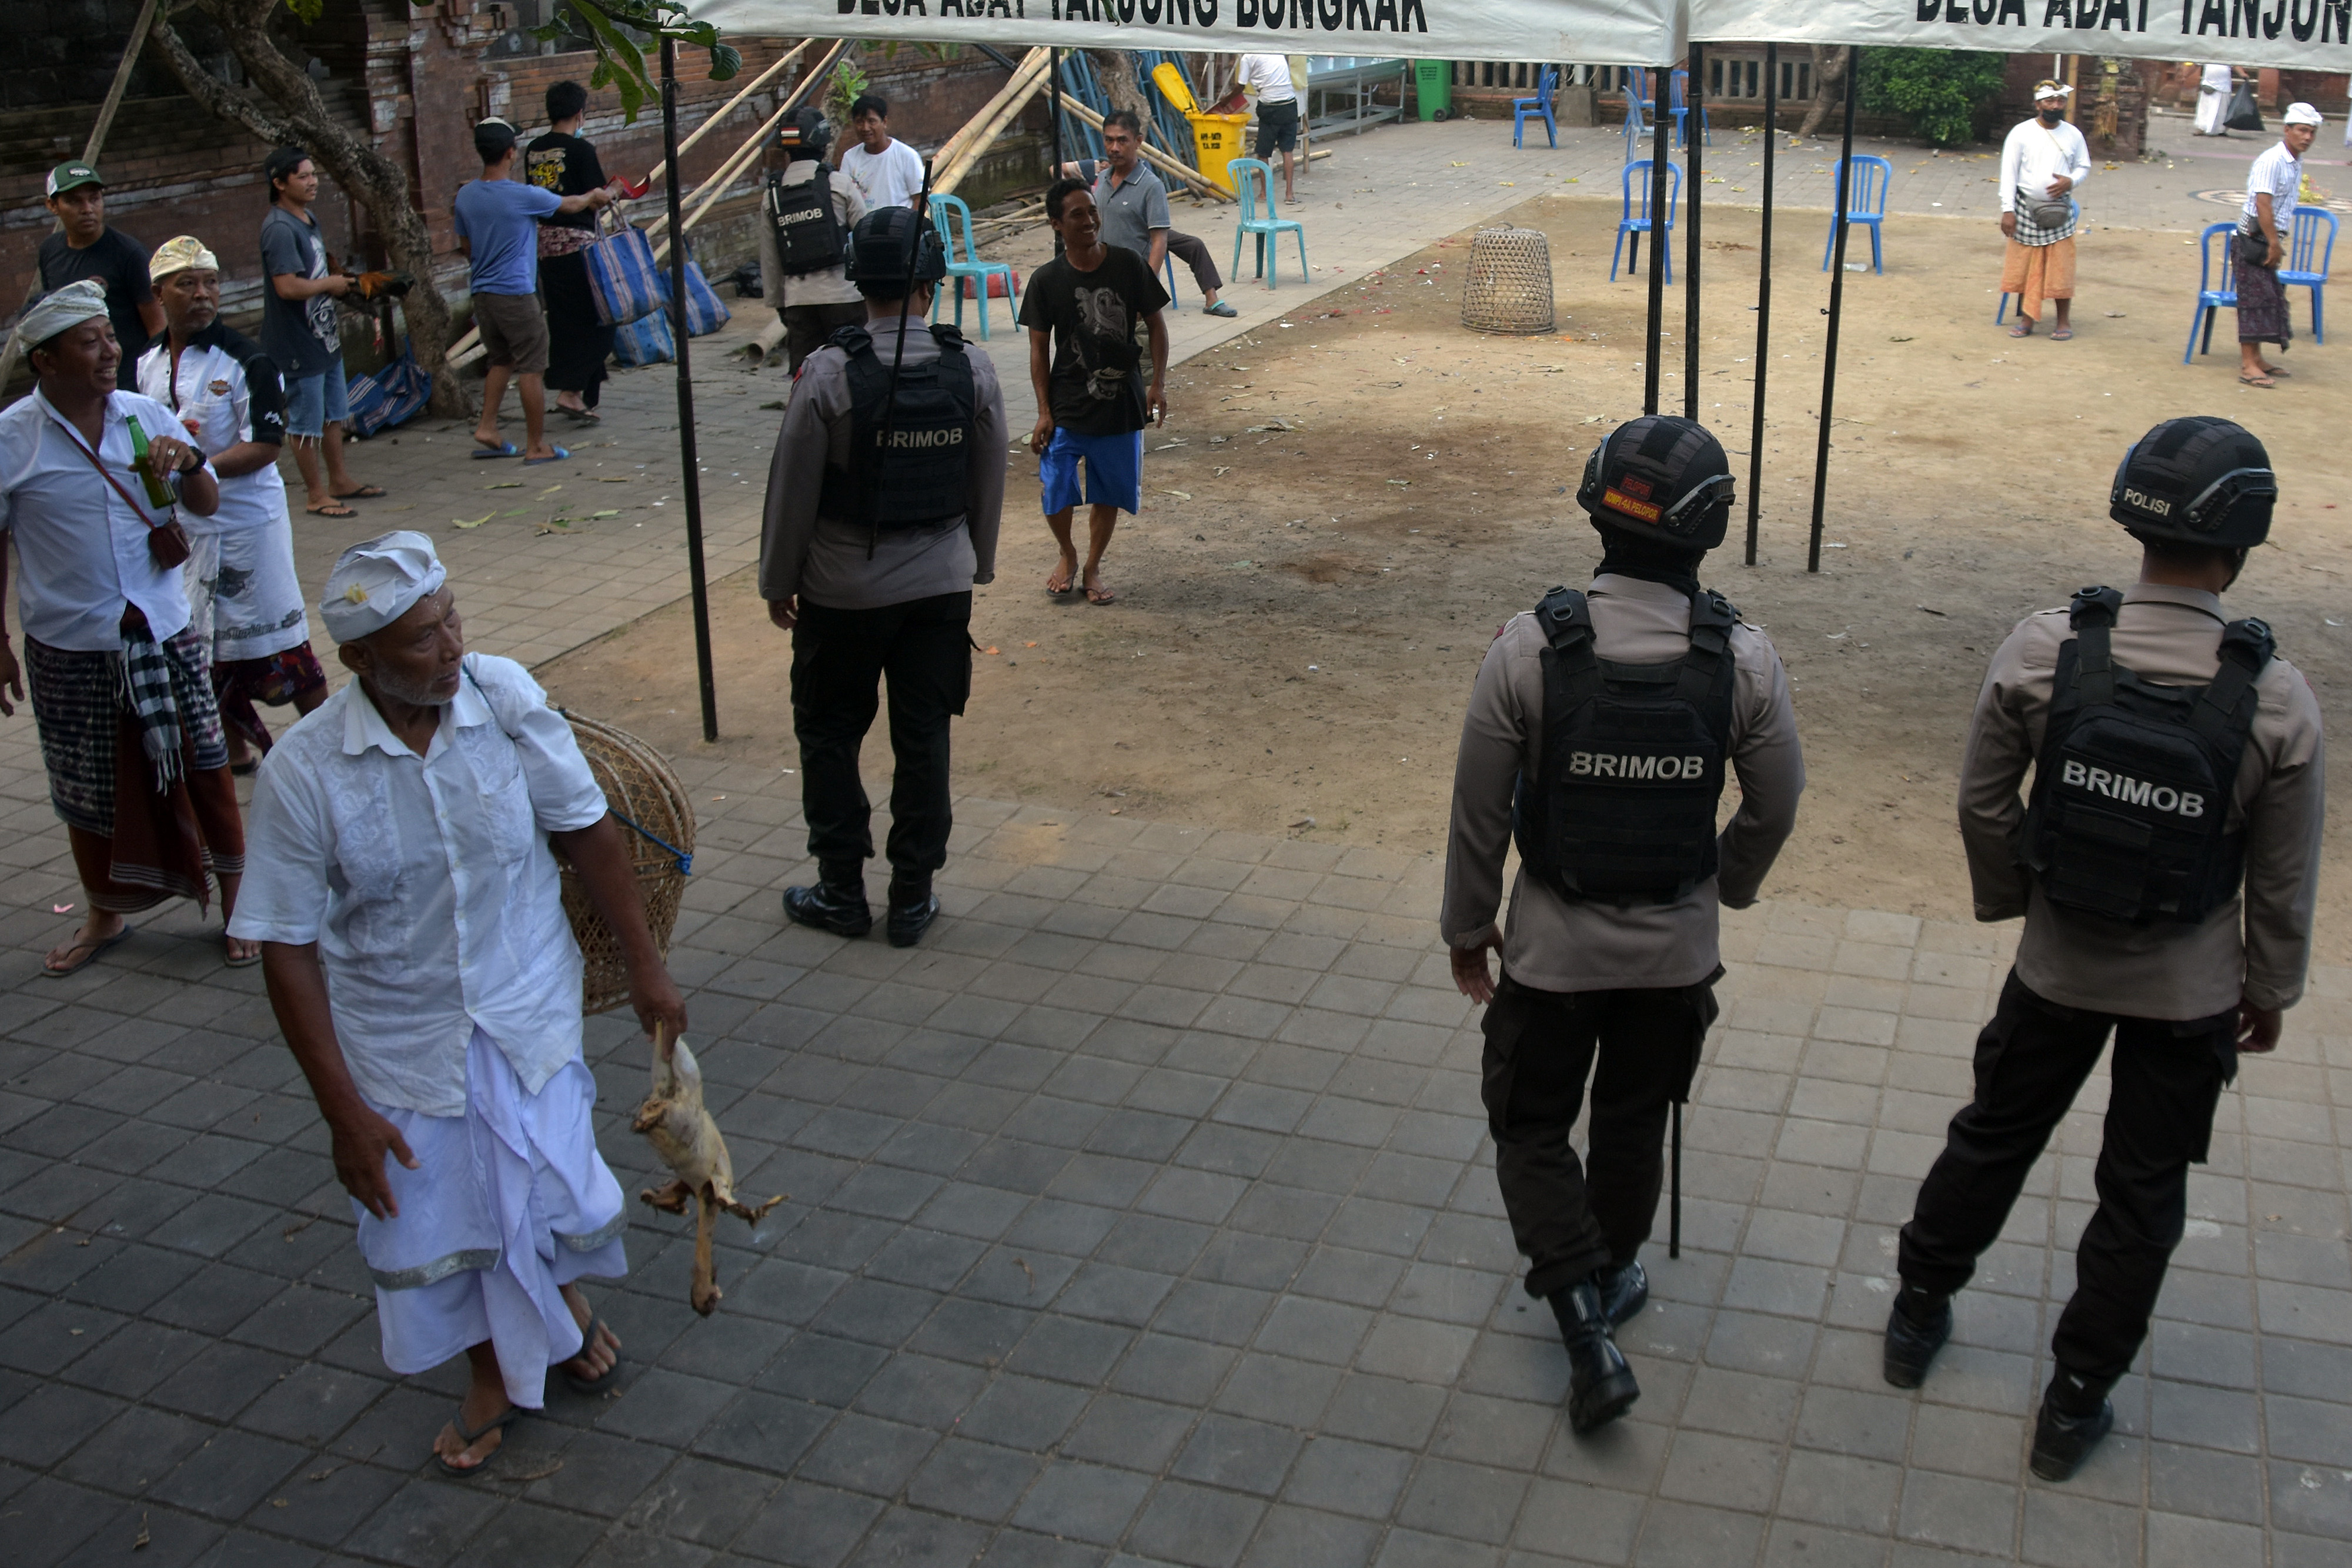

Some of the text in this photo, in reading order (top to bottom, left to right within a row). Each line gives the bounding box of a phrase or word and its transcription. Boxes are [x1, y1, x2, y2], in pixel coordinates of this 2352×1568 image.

[777, 208, 823, 227] BRIMOB
[1604, 491, 1622, 506] KOMPI
[1631, 502, 1659, 520] PELOPOR
[2124, 488, 2171, 516] POLISI
[1569, 751, 1704, 780] BRIMOB
[2062, 759, 2204, 818] BRIMOB
